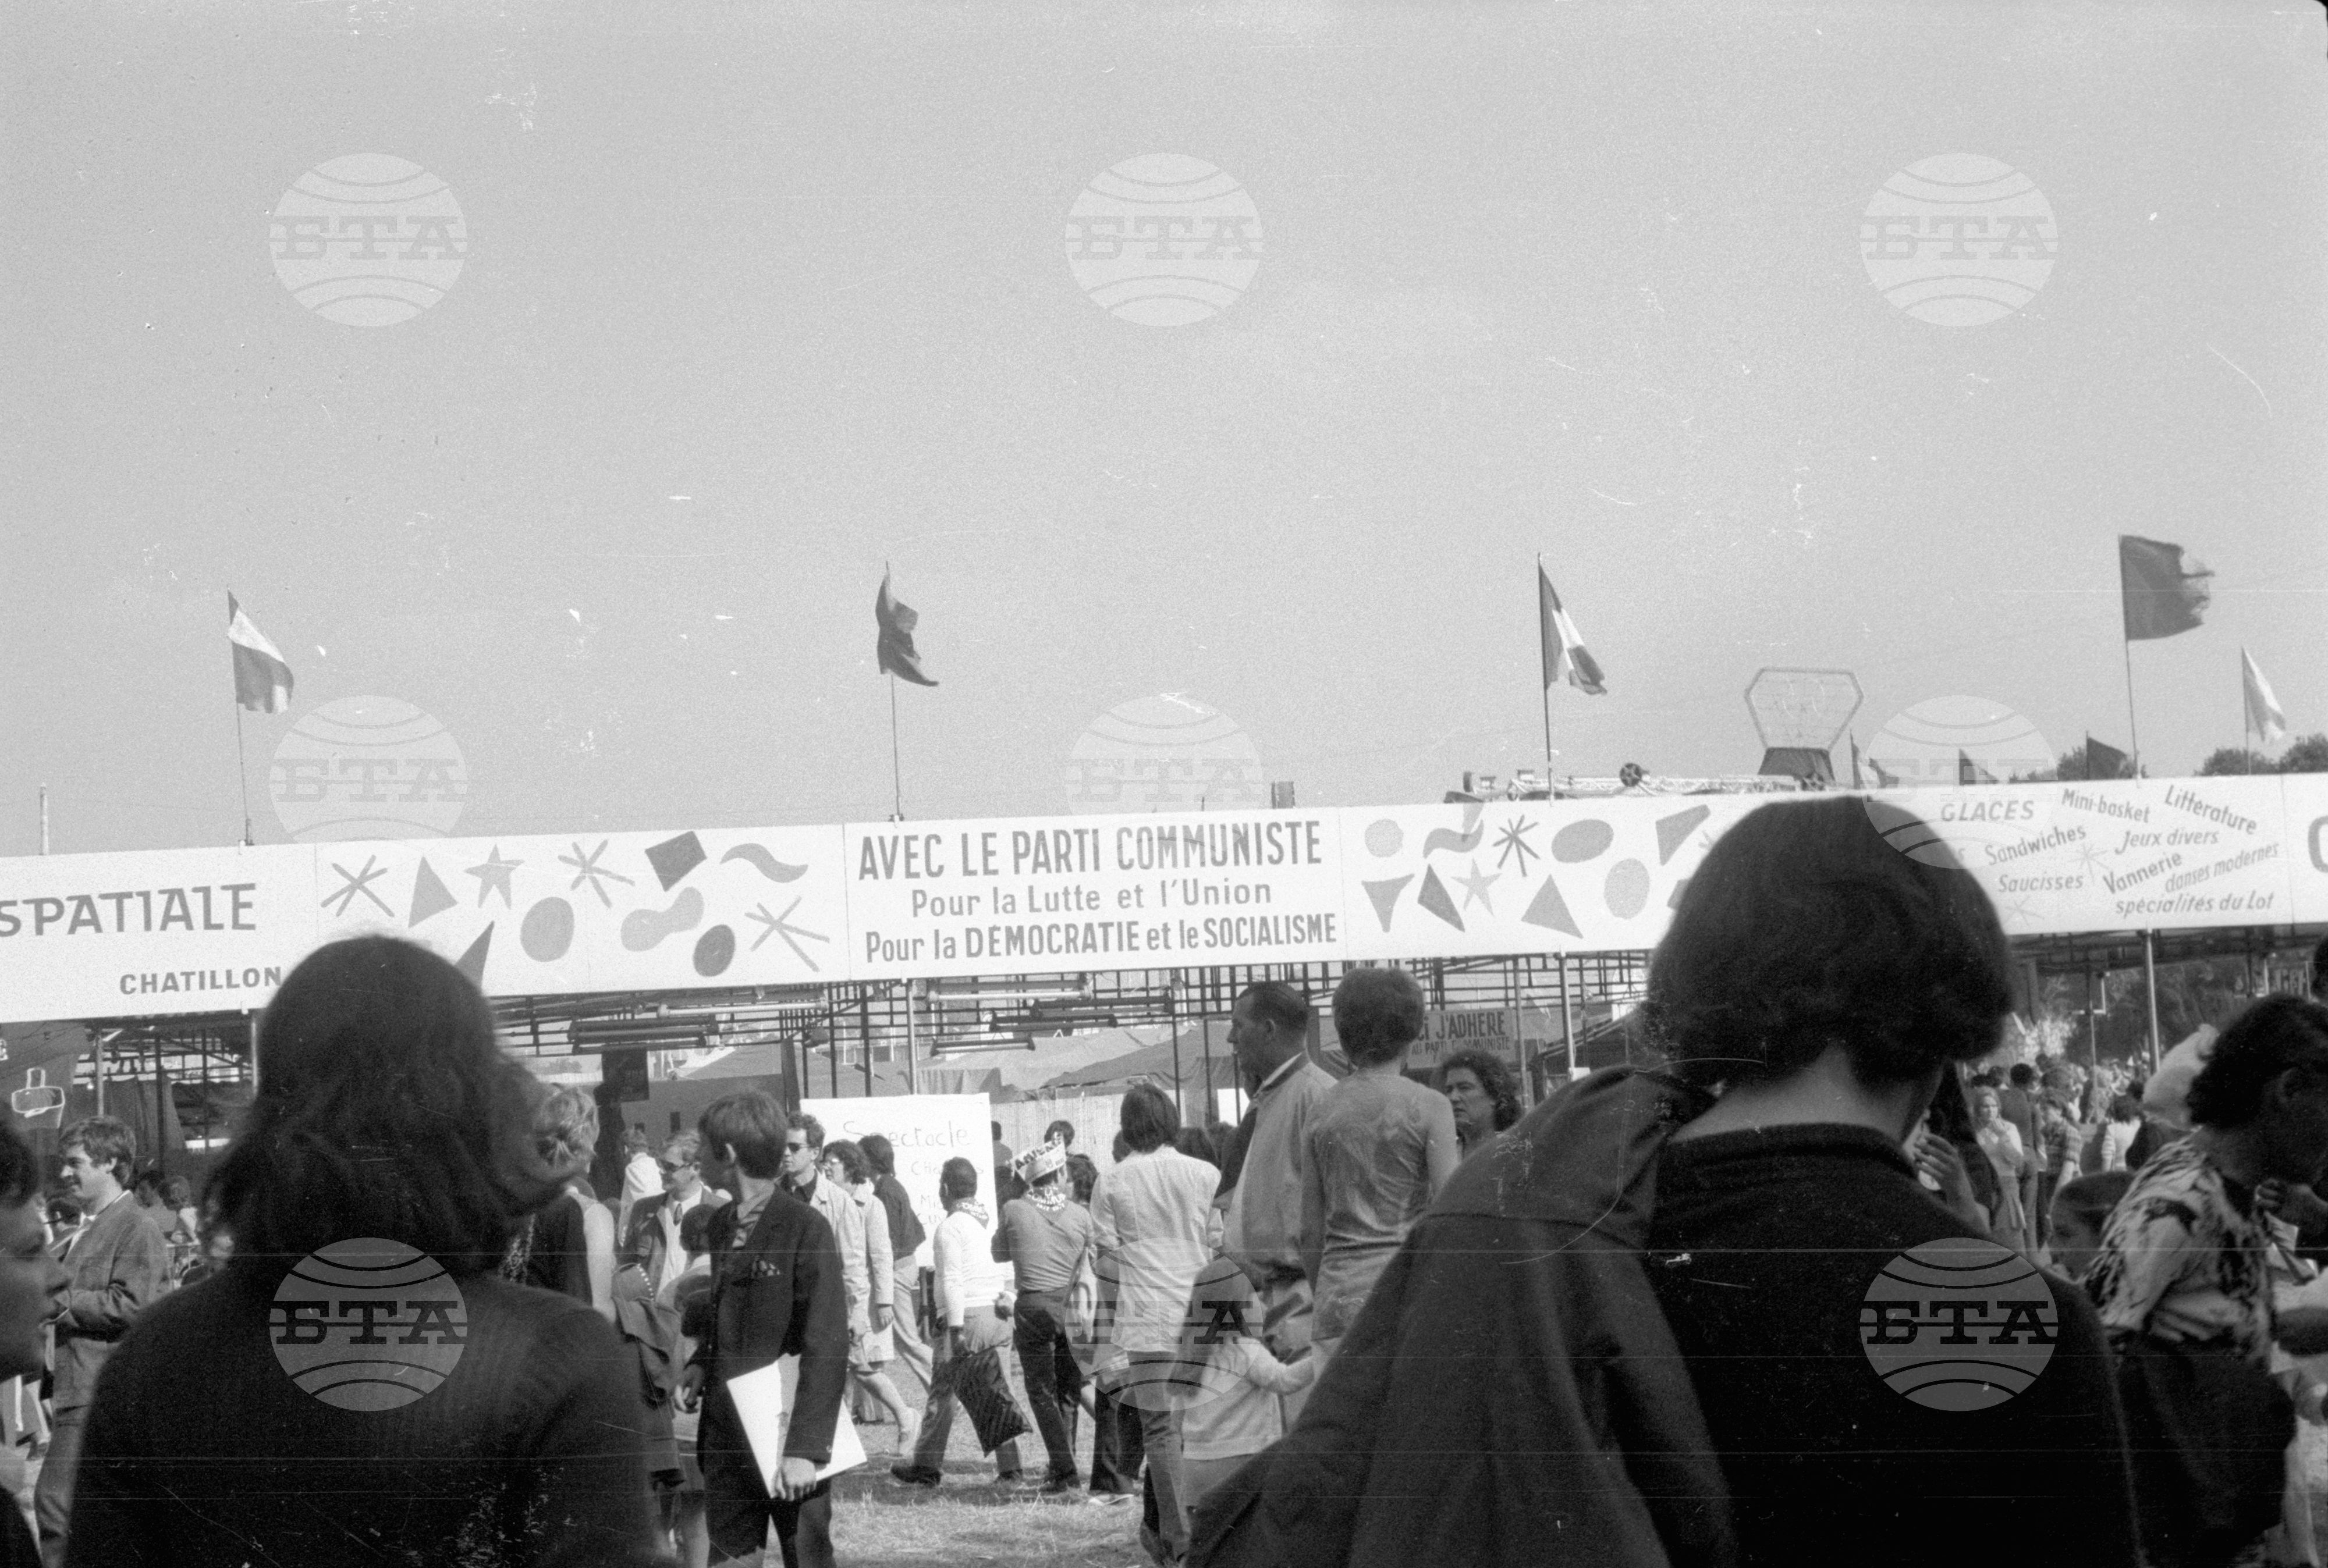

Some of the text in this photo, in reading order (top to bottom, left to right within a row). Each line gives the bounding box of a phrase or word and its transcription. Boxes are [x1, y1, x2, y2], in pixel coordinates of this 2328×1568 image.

[1941, 800, 2034, 822] GLACES
[858, 821, 1322, 880] AVEC LE PARTI COMMUNISTE
[1985, 826, 2086, 866] Sandwiches
[2114, 827, 2219, 855] Jeux divers
[1999, 872, 2084, 893] Saucisses
[2103, 852, 2182, 894] Vannerie
[2165, 865, 2210, 893] danses
[2213, 844, 2279, 877] modernes
[0, 883, 256, 937] SPATIALE
[912, 877, 1271, 918] Pour la Lutte et l'Union
[2219, 893, 2244, 911] du
[2247, 889, 2274, 910] Lot
[866, 931, 925, 963] Pour
[934, 929, 956, 959] la
[1147, 922, 1172, 950] et
[1179, 919, 1198, 949] le
[1204, 913, 1336, 948] SOCIALISME
[120, 966, 282, 995] CHATILLON
[843, 1120, 971, 1147] Sectacle
